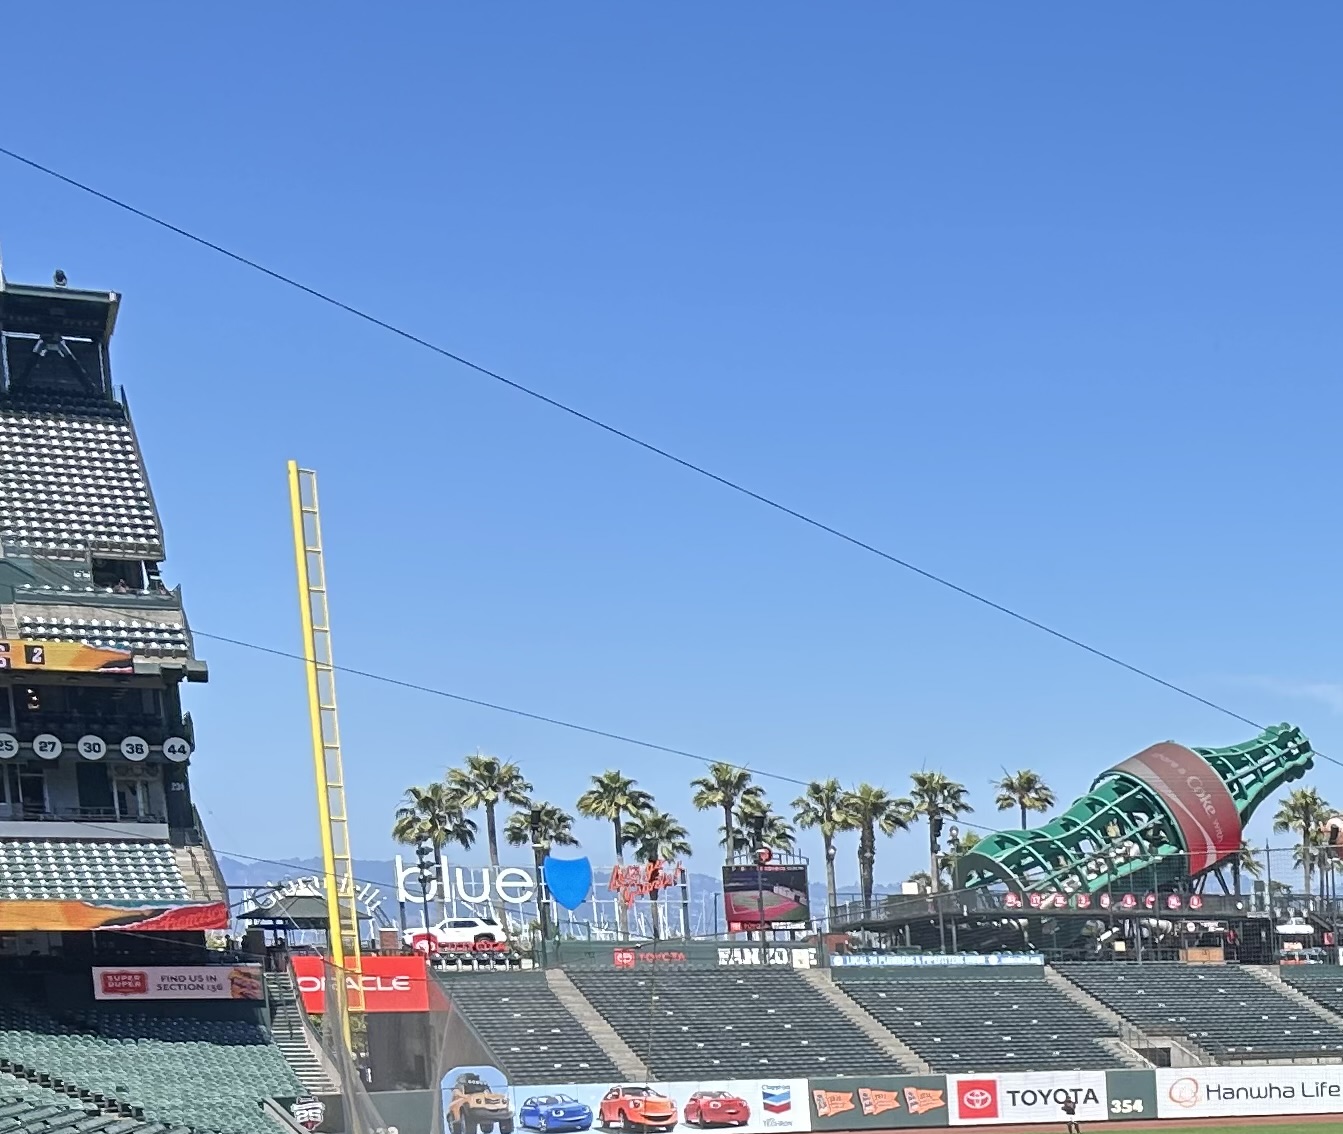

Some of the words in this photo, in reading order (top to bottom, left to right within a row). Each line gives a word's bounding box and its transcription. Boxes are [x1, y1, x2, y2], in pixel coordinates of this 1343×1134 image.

[32, 647, 43, 663] 2
[38, 741, 57, 753] 27
[83, 742, 101, 754] 30
[167, 744, 187, 755] 44
[1186, 775, 1216, 819] Coke
[395, 854, 535, 903] blue
[717, 947, 760, 965] FAN
[761, 947, 817, 966] ZOE
[160, 974, 186, 982] FIND
[188, 974, 204, 983] US
[206, 974, 217, 982] IN
[156, 983, 205, 991] SECTION
[1006, 1087, 1099, 1107] TOYOTA
[1205, 1081, 1295, 1101] Hanwha
[1301, 1080, 1342, 1099] Life
[1111, 1098, 1144, 1114] 354
